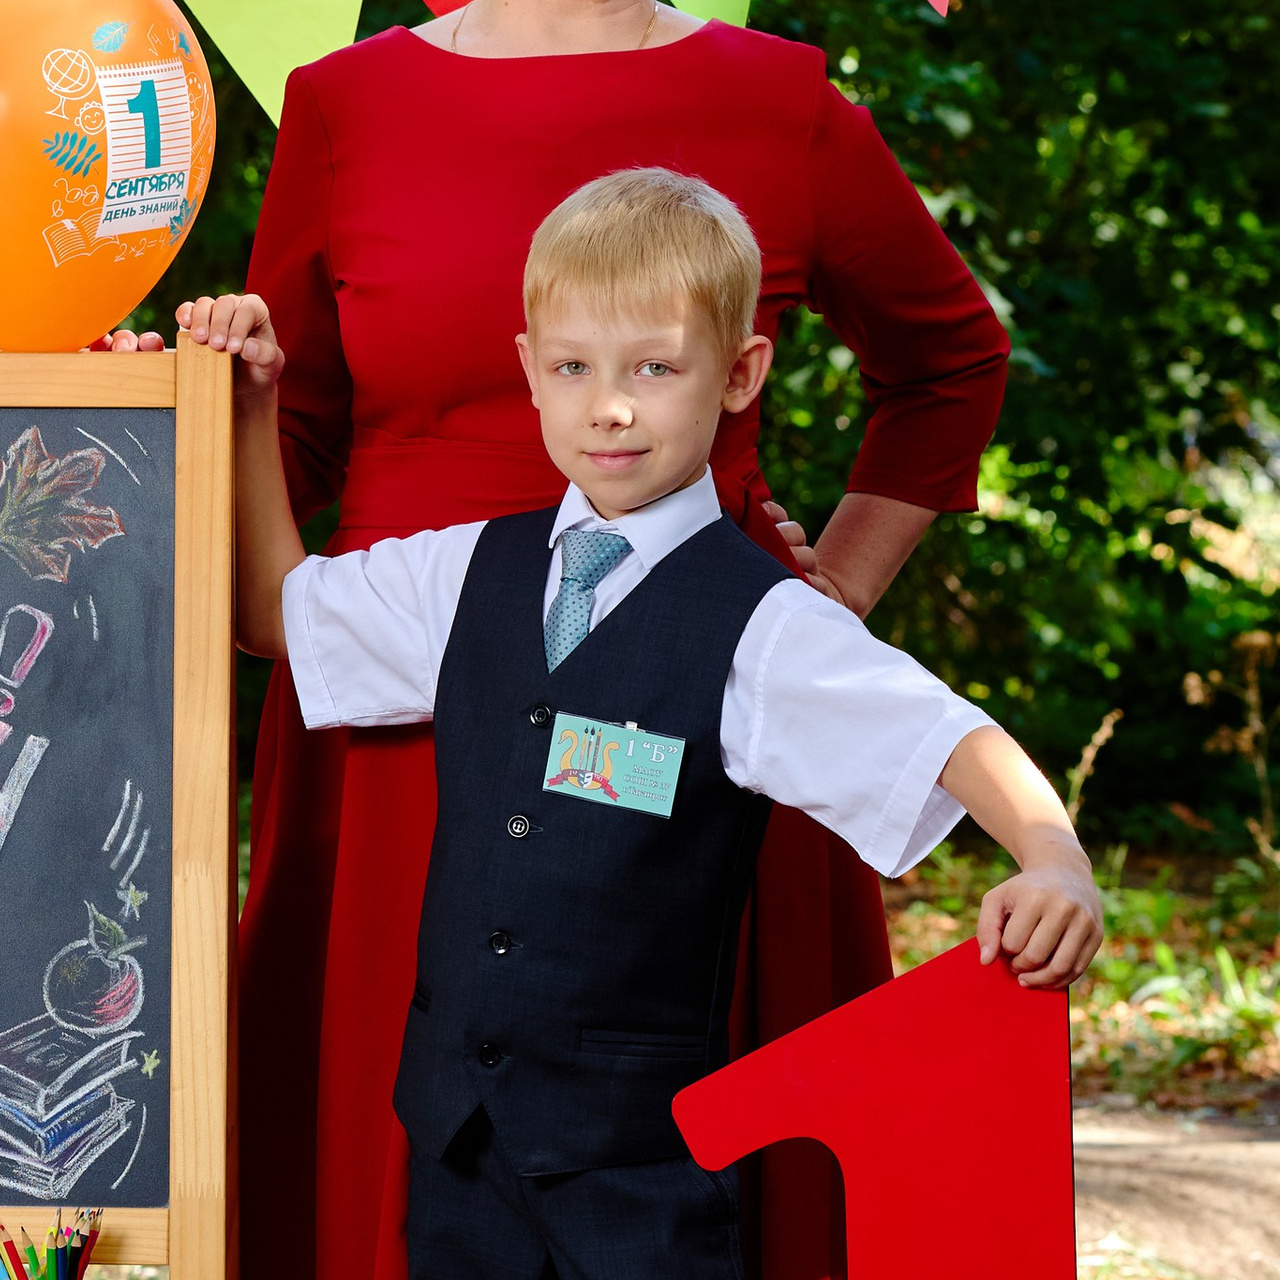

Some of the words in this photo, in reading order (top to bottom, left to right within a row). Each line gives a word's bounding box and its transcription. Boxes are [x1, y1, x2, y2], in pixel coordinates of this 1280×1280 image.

[126, 79, 161, 169] 1
[105, 171, 186, 200] СЕНТЯБРЯ
[102, 207, 136, 223] ДЕНЬ
[138, 199, 179, 216] ЗНАНИЙ
[626, 739, 636, 757] 1
